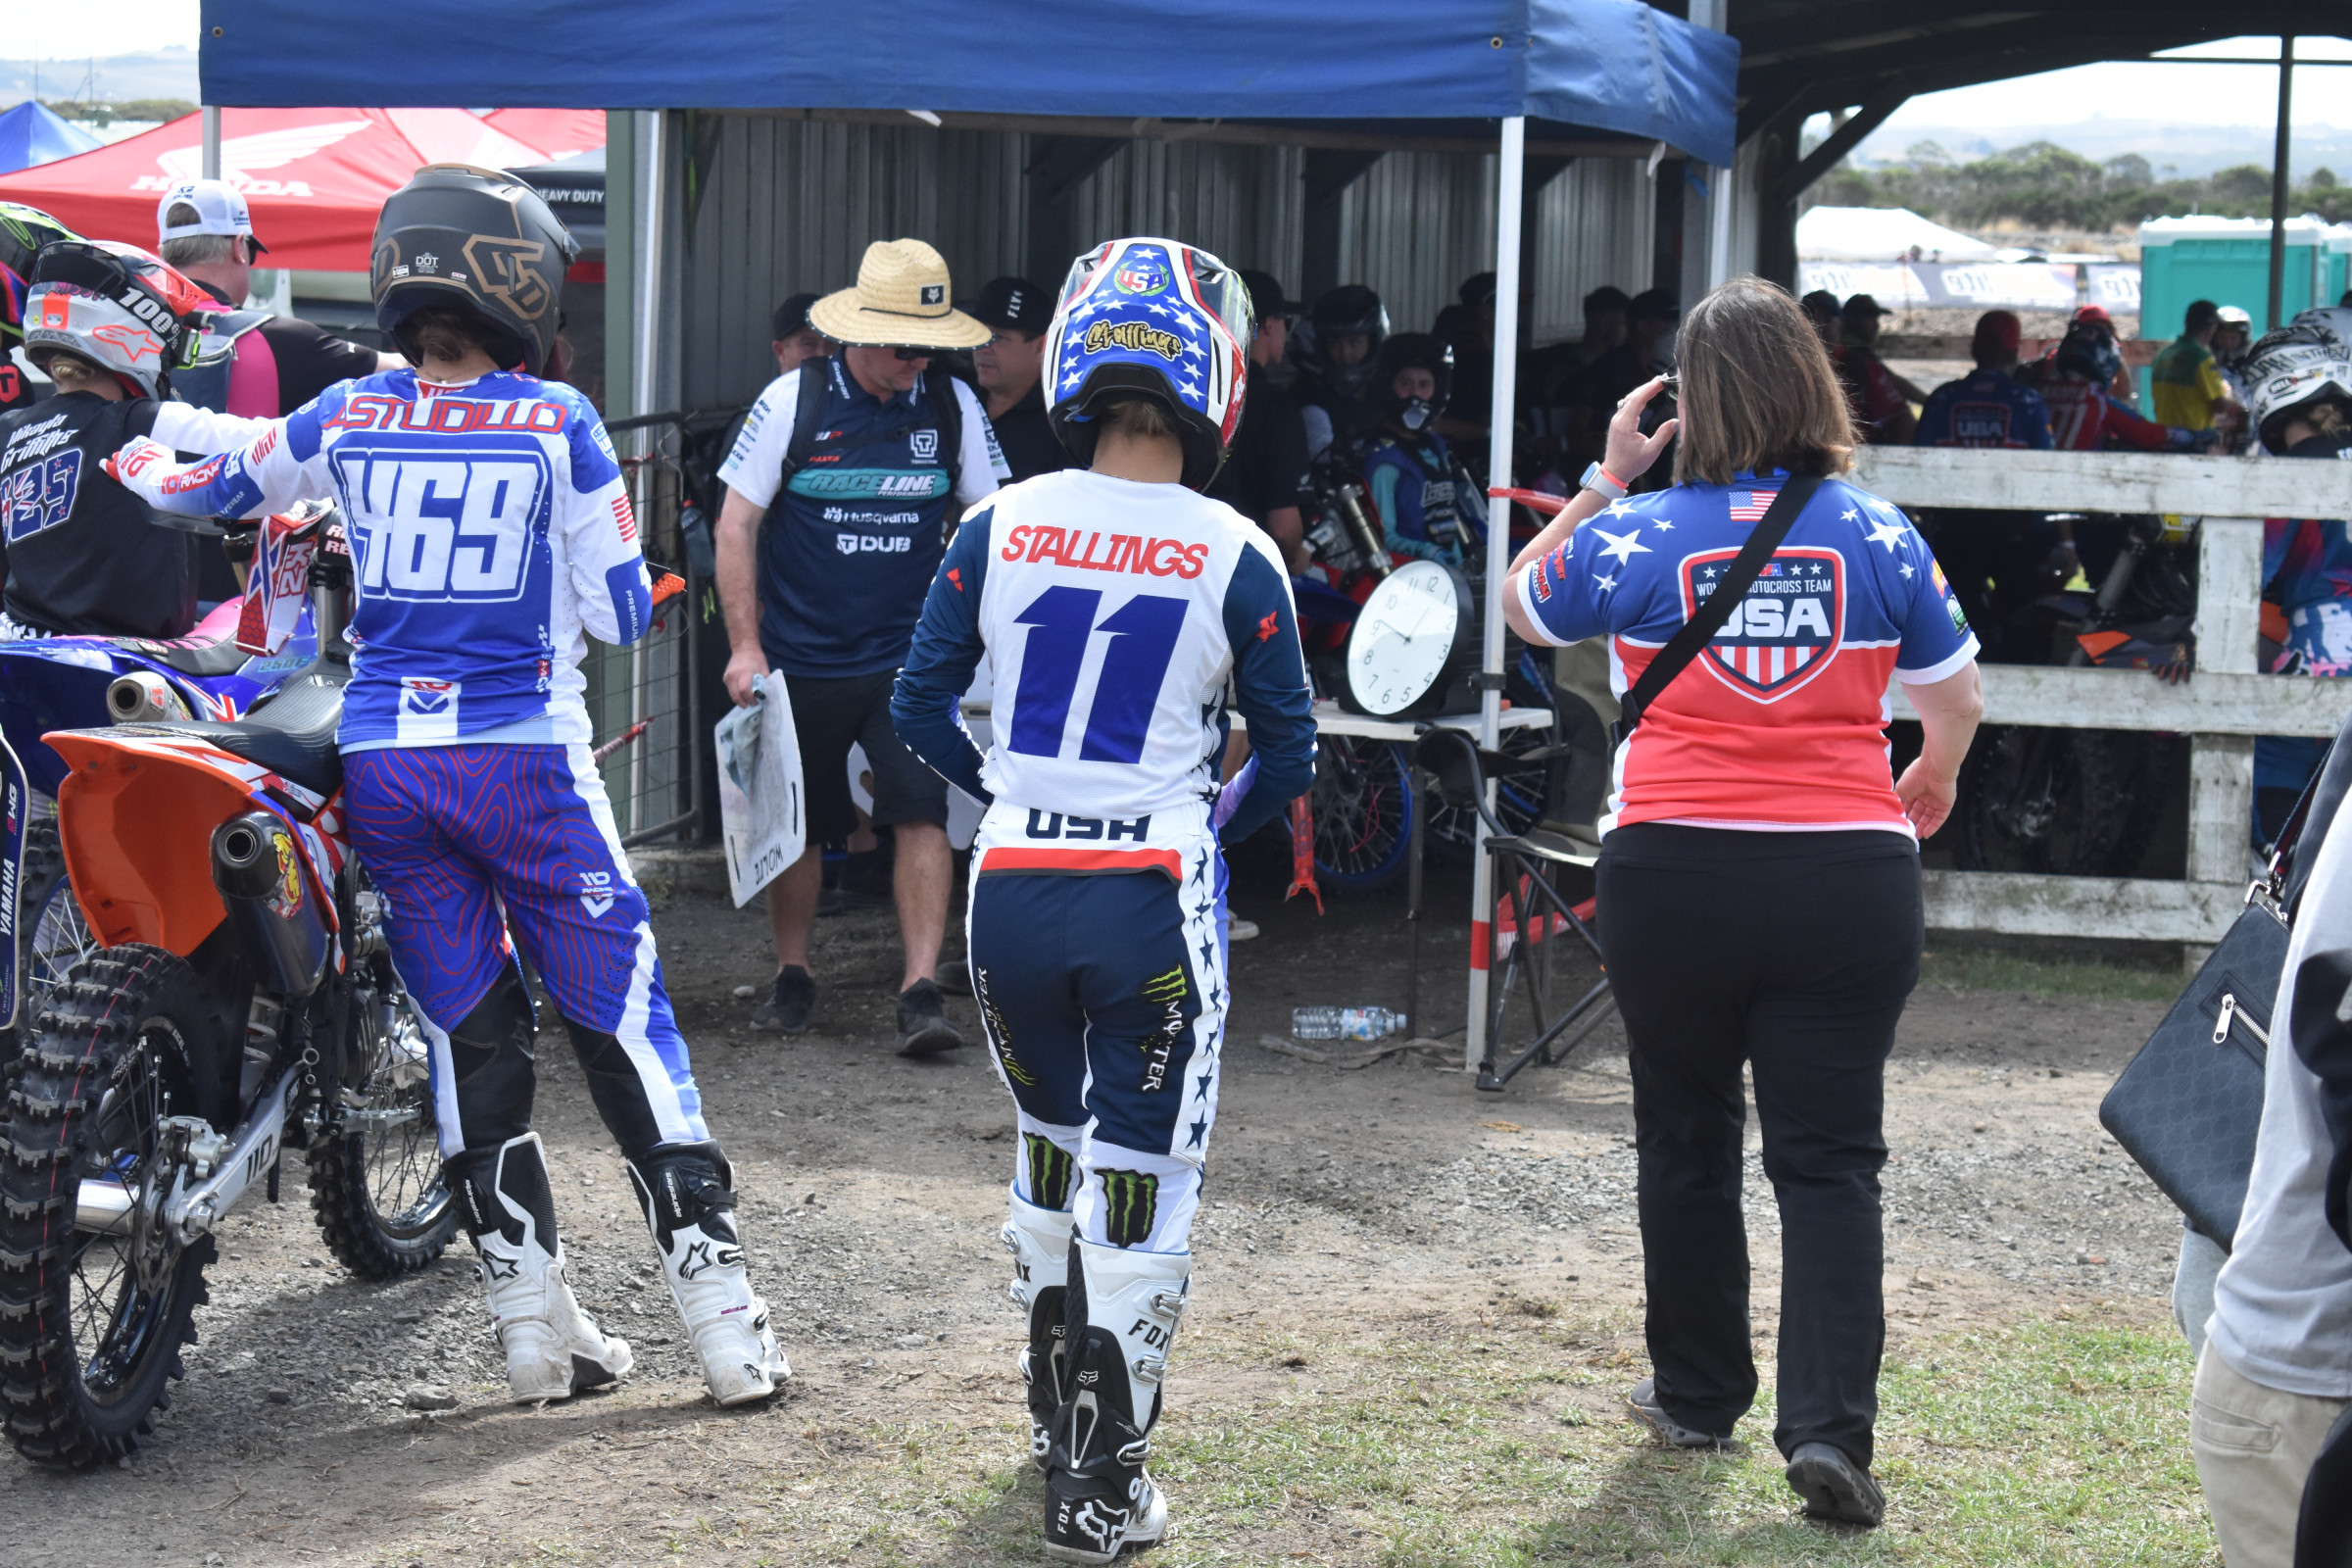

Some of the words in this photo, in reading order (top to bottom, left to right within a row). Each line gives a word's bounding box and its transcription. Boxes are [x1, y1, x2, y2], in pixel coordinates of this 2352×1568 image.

[572, 189, 605, 204] DUTY
[416, 256, 439, 266] DOT
[1118, 271, 1166, 294] USA
[1085, 320, 1183, 360] Stallings
[321, 395, 567, 434] ASTUDILLO
[808, 474, 936, 492] RACELINE
[340, 459, 540, 592] 469
[843, 512, 920, 525] Husqvarna
[860, 535, 911, 552] DUB
[1001, 524, 1209, 580] STALLINGS
[1407, 576, 1420, 595] 11
[1426, 575, 1441, 594] 12
[1804, 578, 1832, 593] TEAM
[1386, 593, 1398, 611] 10
[1444, 589, 1452, 606] 1
[624, 589, 641, 643] PREMIUM
[1445, 613, 1456, 631] 2
[1370, 618, 1382, 636] 9
[1363, 649, 1375, 666] 8
[1439, 643, 1449, 661] 3
[1006, 584, 1190, 764] 11
[1367, 673, 1380, 690] 7
[1423, 671, 1435, 687] 4
[1382, 688, 1393, 705] 6
[1400, 687, 1412, 703] 5
[1025, 808, 1152, 843] USA
[0, 858, 15, 937] YAMAHA
[665, 1172, 681, 1218] alpinestars
[1127, 1318, 1170, 1352] FOX
[1056, 1500, 1071, 1536] FOX
